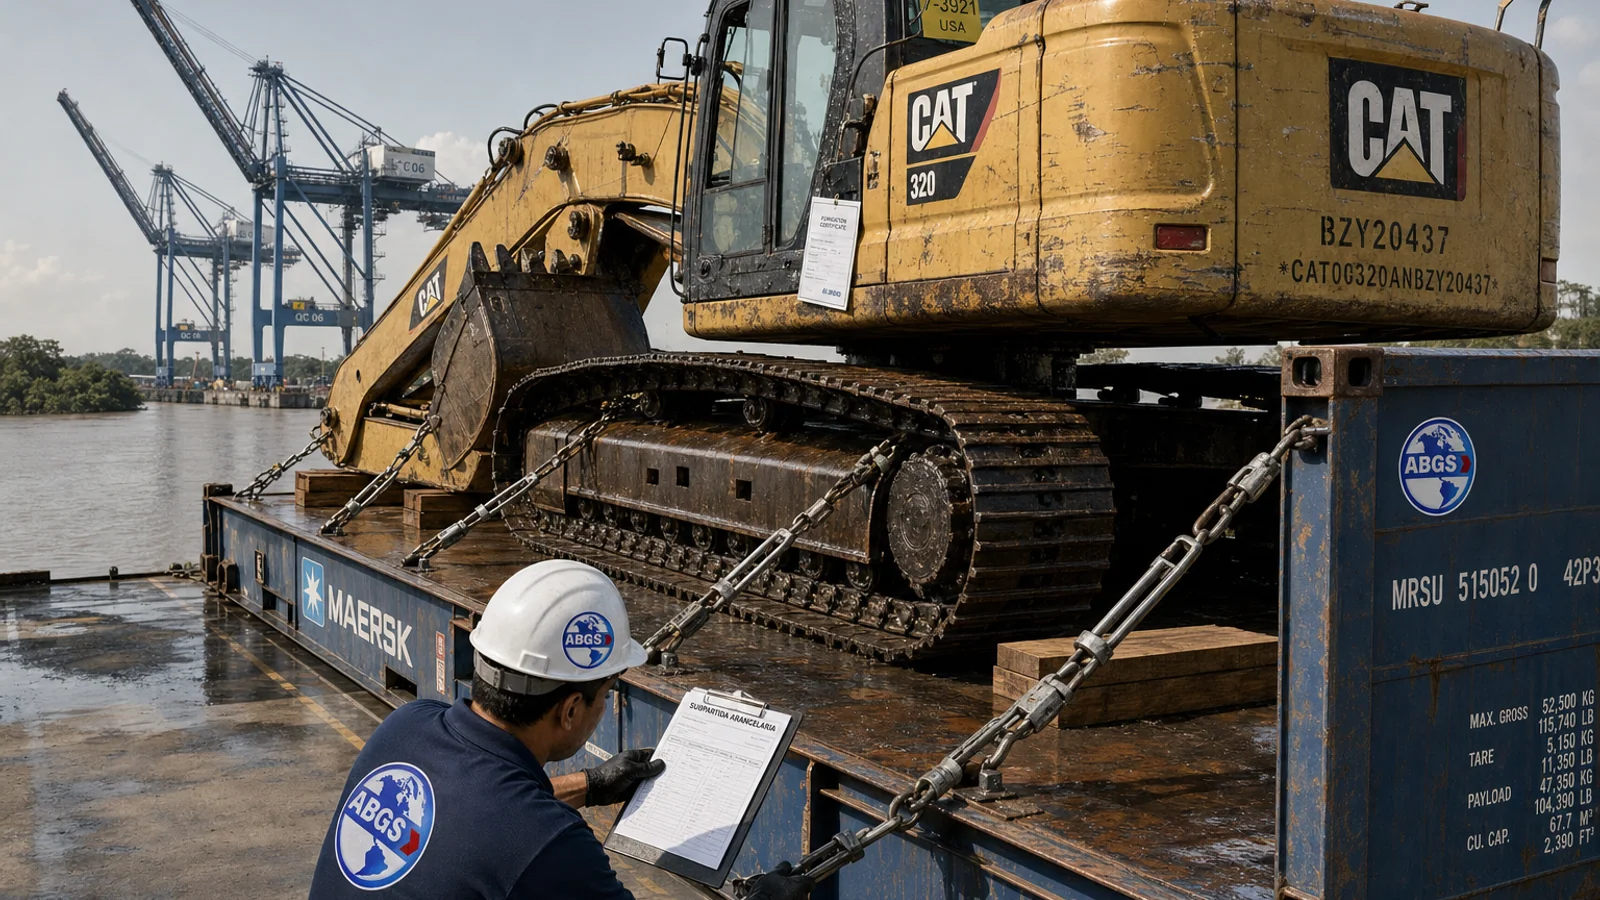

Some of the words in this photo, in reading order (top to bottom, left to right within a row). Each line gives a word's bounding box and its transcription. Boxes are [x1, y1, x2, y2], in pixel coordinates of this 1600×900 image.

[940, 19, 966, 33] USA
[911, 81, 973, 152] CAT
[1348, 80, 1452, 185] CAT
[910, 170, 936, 200] 320
[1320, 215, 1449, 254] BZY20437
[418, 271, 441, 317] CAT
[311, 314, 324, 323] 06
[1404, 454, 1457, 475] ABGS
[1392, 574, 1443, 610] MRSU
[1458, 565, 1520, 602] 515052
[1528, 562, 1538, 592] 0
[1563, 556, 1600, 586] 42P3
[328, 584, 413, 668] MAERSK
[565, 633, 602, 646] ABGS
[1469, 711, 1496, 729] MAX.
[1499, 706, 1529, 724] GROSS
[1542, 692, 1577, 715] 52,500
[1582, 689, 1595, 706] KG
[1538, 712, 1577, 734] 115,740
[1581, 709, 1594, 726] LB
[1469, 749, 1494, 767] TARE
[1547, 732, 1576, 754] 5,150
[1580, 729, 1594, 746] KG
[1541, 752, 1575, 774] 11,350
[1580, 748, 1593, 766] LB
[1468, 786, 1512, 809] PAYLOAD
[1540, 772, 1575, 793] 47,350
[1580, 768, 1593, 786] KG
[1534, 791, 1574, 815] 104,390
[1580, 788, 1593, 805] LB
[348, 790, 407, 842] ABGS
[1467, 835, 1484, 851] CU.
[1488, 828, 1510, 847] CAP.
[1549, 813, 1572, 833] 67.7
[1544, 831, 1574, 854] 2,390
